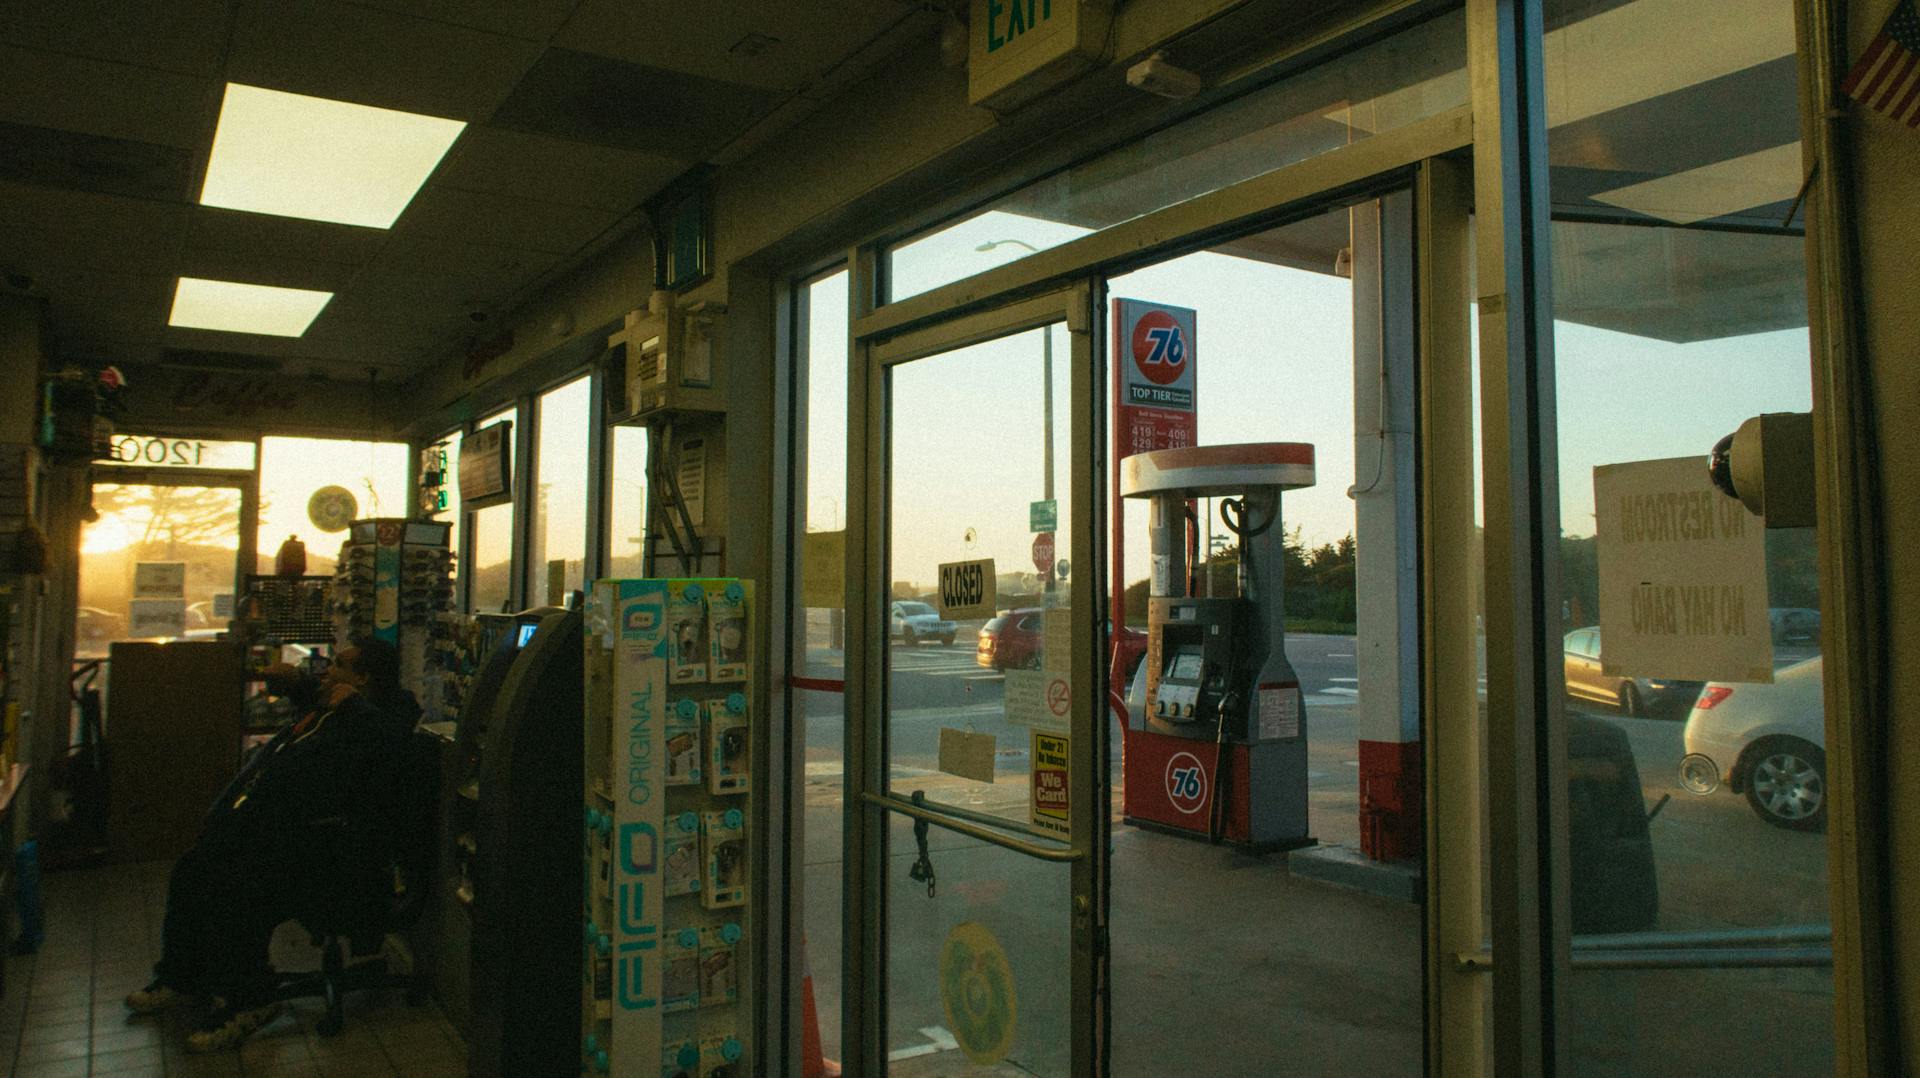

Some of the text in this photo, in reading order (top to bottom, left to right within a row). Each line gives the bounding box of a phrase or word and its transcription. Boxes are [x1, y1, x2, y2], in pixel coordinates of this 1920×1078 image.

[1144, 326, 1184, 366] 76
[1132, 387, 1151, 399] TOP
[1152, 389, 1171, 401] TIER
[1132, 426, 1152, 437] 419
[1033, 545, 1054, 560] STOP
[942, 564, 983, 608] CLOSED
[629, 682, 653, 805] ORIGINAL
[1040, 772, 1062, 788] We
[1172, 767, 1201, 801] 76
[1036, 786, 1067, 802] Card
[619, 822, 658, 1010] FIFO
